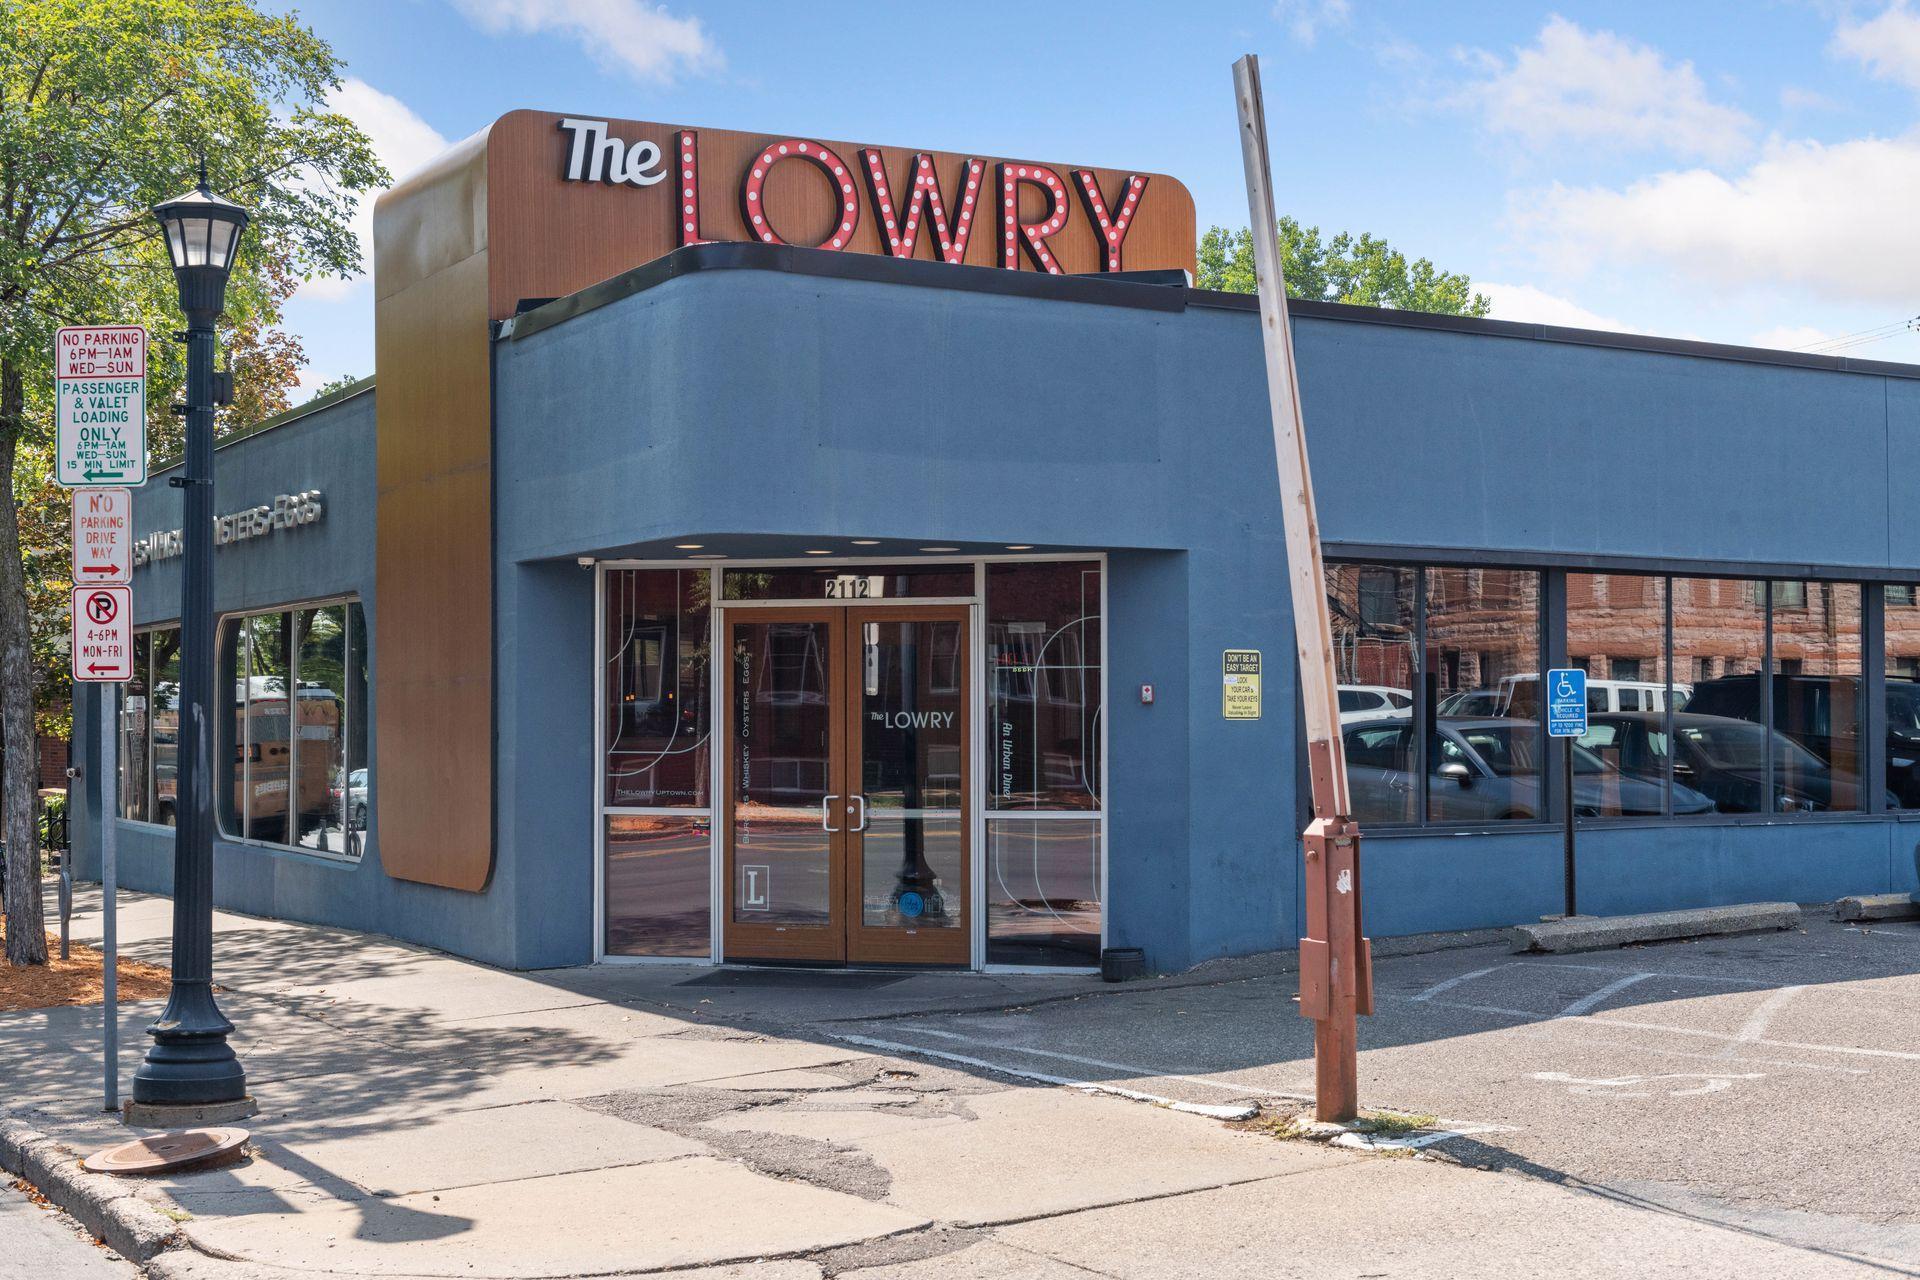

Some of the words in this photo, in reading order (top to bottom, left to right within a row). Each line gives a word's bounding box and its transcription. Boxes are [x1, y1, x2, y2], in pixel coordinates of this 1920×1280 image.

[559, 117, 667, 187] The
[675, 130, 1150, 275] LOWRY
[63, 334, 79, 346] NO
[84, 333, 139, 346] PARKING
[69, 362, 133, 374] WED-SUN
[62, 382, 139, 395] PASSENGER
[74, 397, 84, 409] &
[89, 396, 128, 409] VALET
[73, 411, 129, 423] LOADING
[80, 427, 121, 441] ONLY
[76, 451, 127, 459] WED-SUN
[67, 461, 77, 469] 15
[84, 460, 103, 469] MIN
[109, 460, 136, 469] LIMIT
[90, 495, 113, 513] NO
[81, 516, 123, 529] PARKING
[86, 532, 117, 544] DRIVE
[91, 547, 112, 559] WAY
[826, 579, 868, 599] 2112
[87, 629, 118, 642] 4-6PM
[82, 645, 122, 658] MON-FRI
[1228, 654, 1242, 662] DON'T
[1243, 654, 1250, 662] BE
[1250, 654, 1258, 663] AN
[742, 655, 750, 684] EGGS
[1226, 663, 1239, 671] EASY
[1240, 663, 1258, 671] TARGET
[742, 690, 750, 738] OYSTERS
[871, 712, 885, 721] The
[885, 711, 954, 729] LOWRY
[1003, 722, 1013, 737] An
[1003, 740, 1013, 770] Urban
[742, 744, 750, 789] WHISKEY
[1003, 773, 1013, 800] Diner
[747, 870, 764, 905] L
